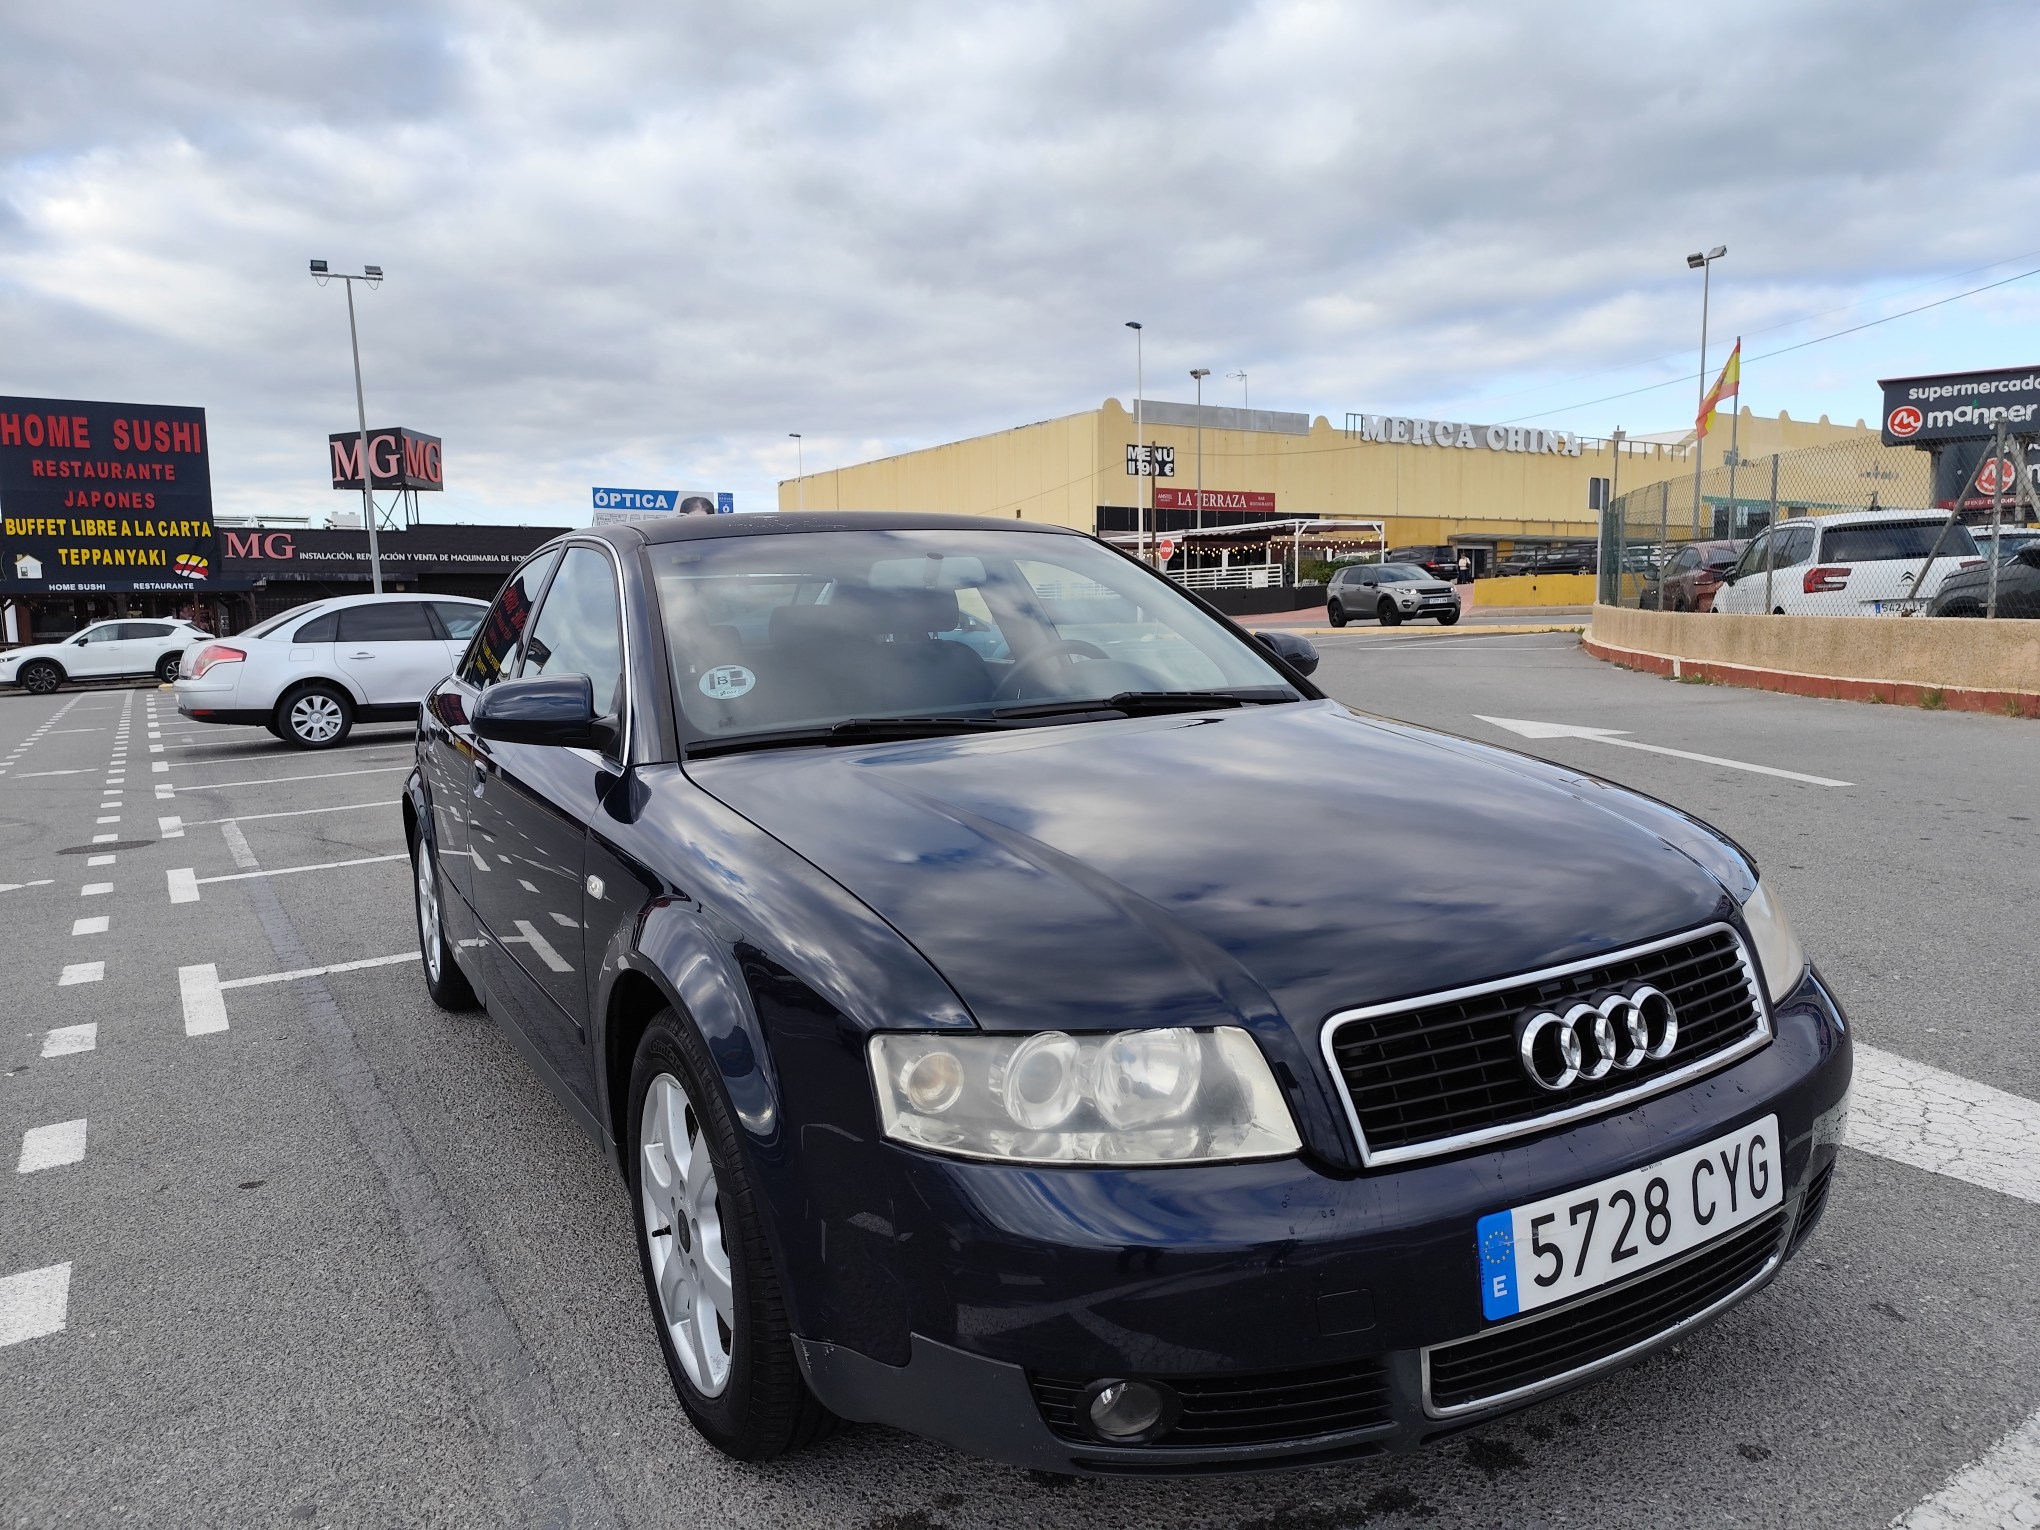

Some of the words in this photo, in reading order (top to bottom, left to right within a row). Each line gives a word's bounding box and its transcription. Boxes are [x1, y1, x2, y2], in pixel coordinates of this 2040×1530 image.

[1926, 404, 2038, 430] manper
[0, 413, 91, 449] HOME
[113, 418, 201, 453] SUSHI
[1361, 413, 1477, 449] MERCA
[1486, 425, 1581, 457] CHINA
[330, 434, 400, 482] MG
[402, 435, 442, 484] MG
[1127, 446, 1174, 462] MENÚ
[32, 459, 176, 481] RESTAURANTE
[64, 490, 156, 509] JAPONES
[594, 490, 669, 509] ÓPTICA
[1177, 492, 1192, 506] LA
[1194, 493, 1247, 508] TERRAZA
[5, 518, 66, 536] BUFFET
[71, 518, 117, 536] LIBRE
[121, 519, 132, 537] A
[134, 520, 155, 537] LA
[157, 520, 212, 538] CARTA
[58, 548, 167, 566] TEPPANYAKI
[223, 532, 296, 560] MG
[299, 551, 355, 561] INSTALACIÓN,
[406, 553, 413, 561] Y
[413, 553, 438, 561] VENTA
[439, 553, 449, 561] DE
[450, 554, 500, 562] MAQUINARIA
[48, 583, 76, 591] HOME
[77, 583, 106, 591] SUSHI
[133, 582, 194, 590] RESTAURANTE
[1531, 1177, 1672, 1287] 5728
[1692, 1134, 1769, 1226] CYG
[1493, 1275, 1508, 1298] E
